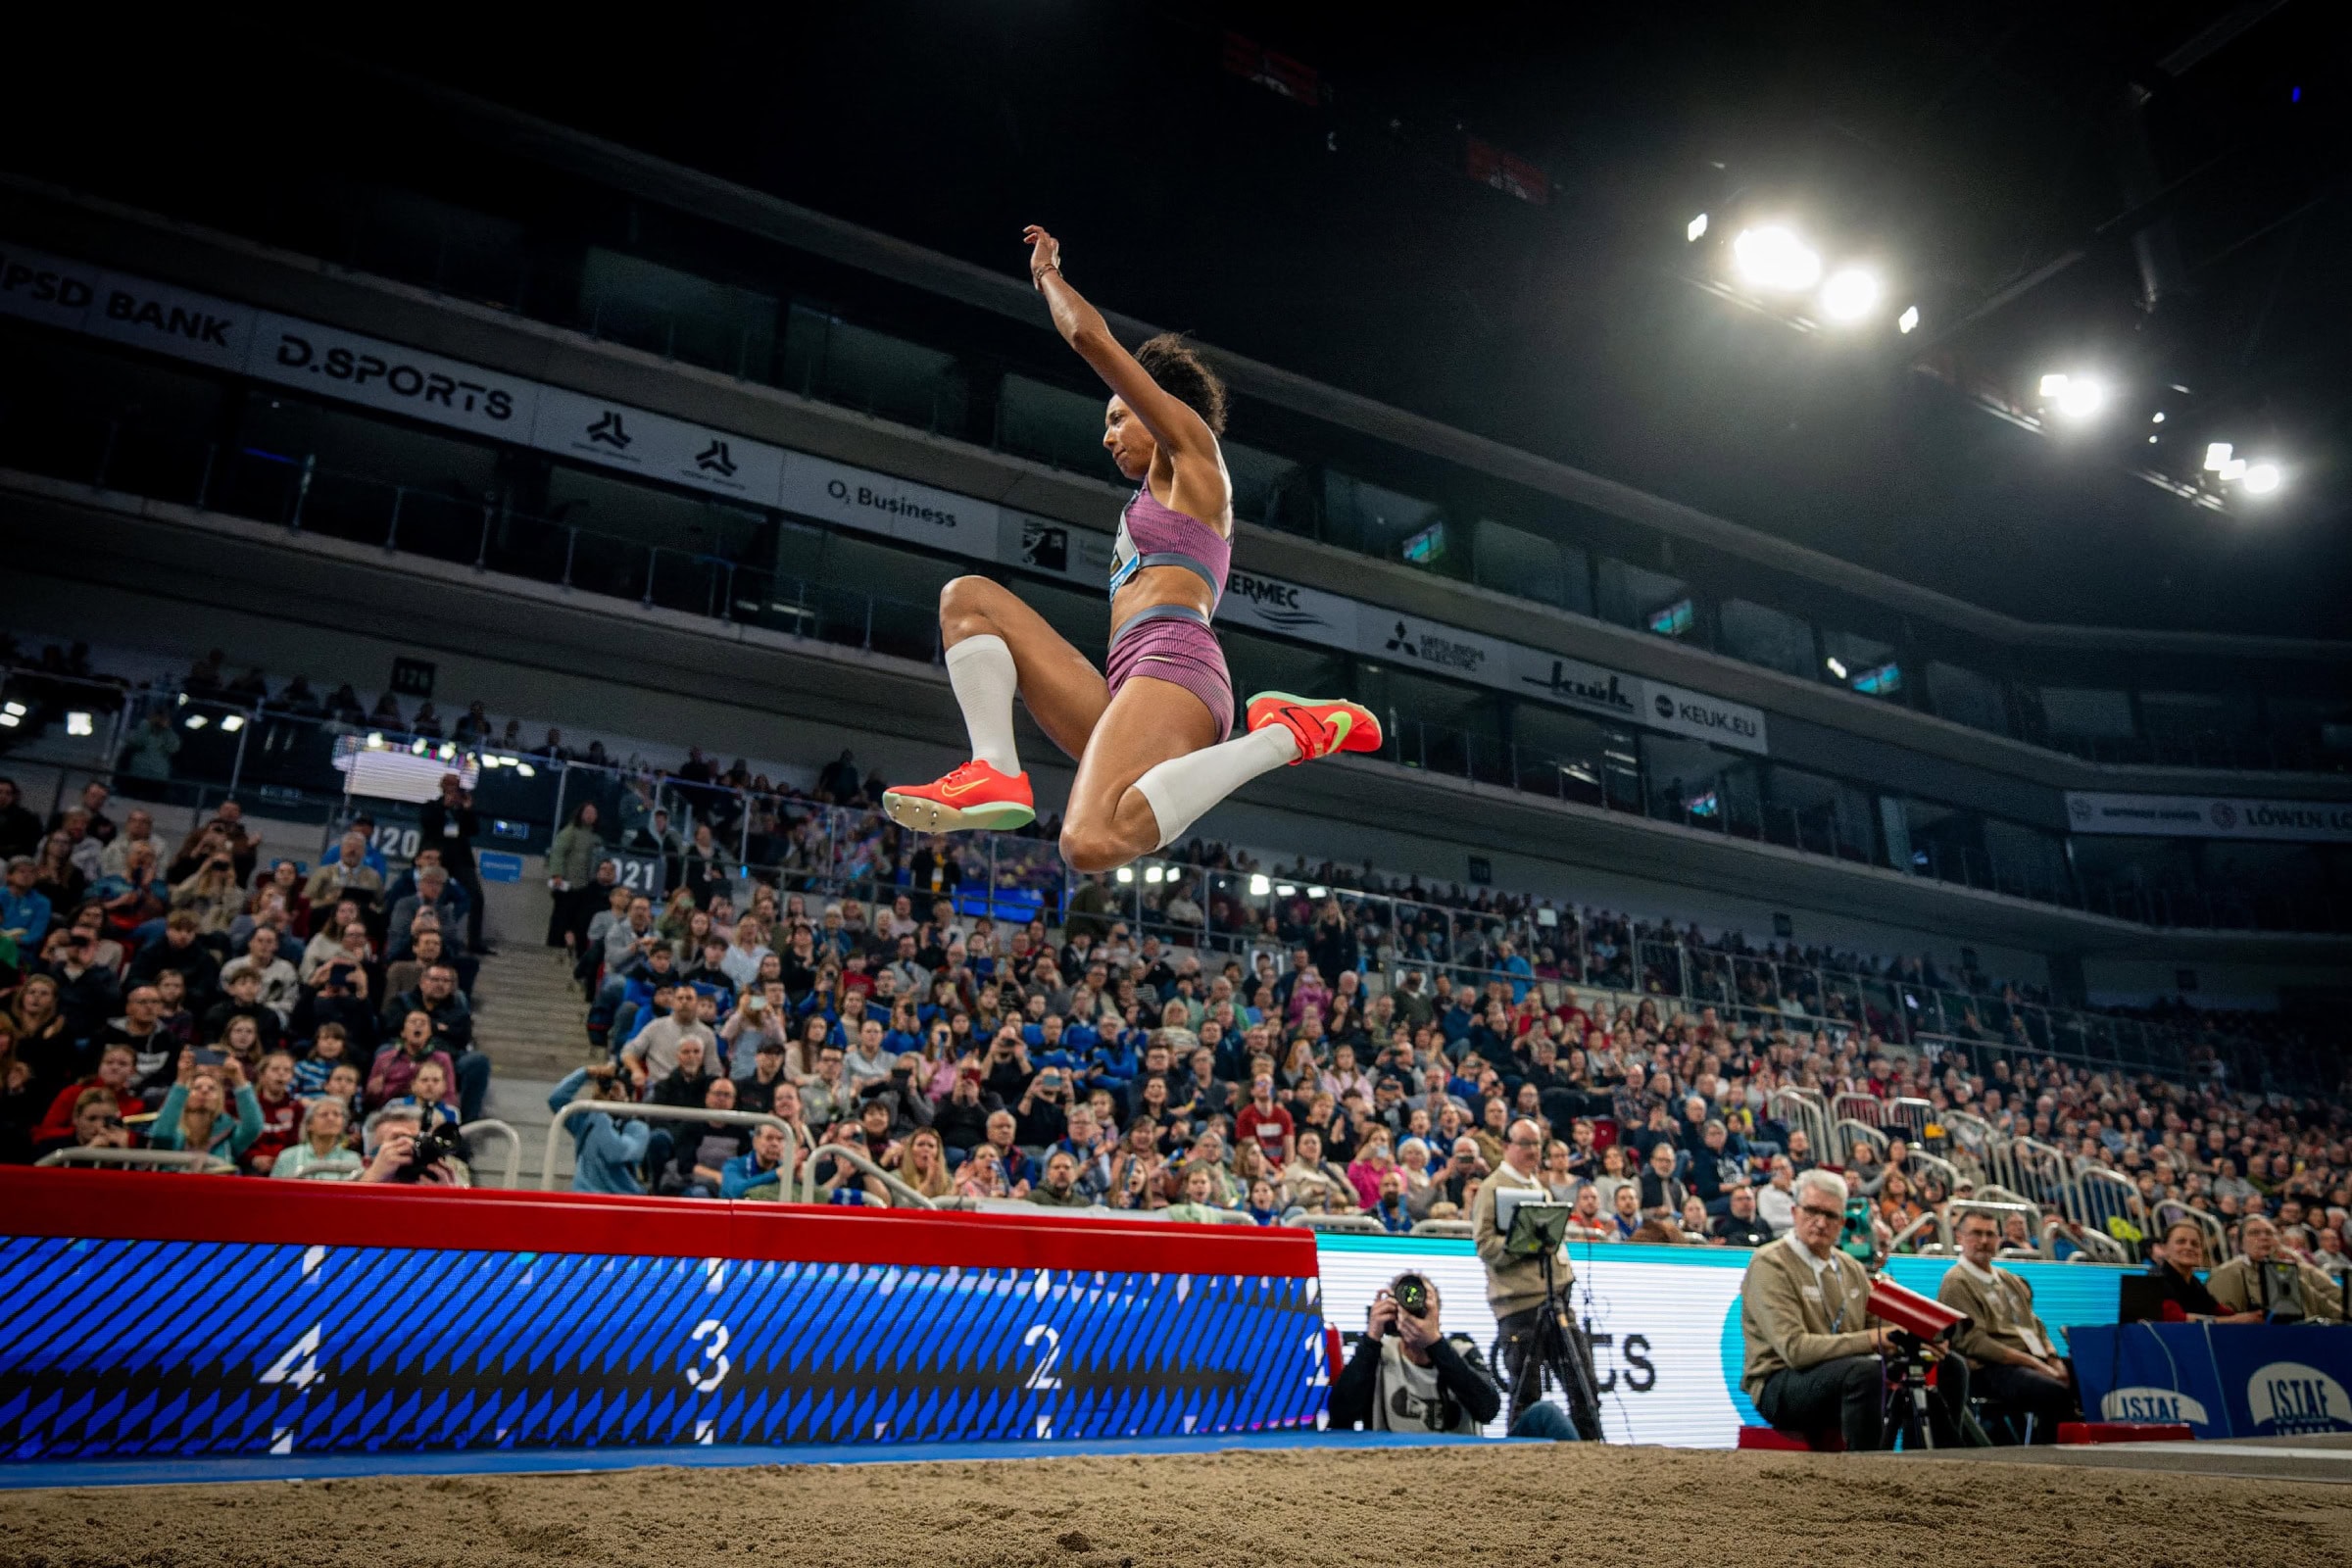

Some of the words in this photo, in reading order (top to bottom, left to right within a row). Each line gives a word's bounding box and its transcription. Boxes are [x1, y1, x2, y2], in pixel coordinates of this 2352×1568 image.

[3, 265, 94, 307] PSD
[106, 290, 232, 347] BANK
[277, 334, 514, 420] D.SPORTS
[857, 487, 957, 527] Business
[1232, 575, 1300, 612] ERMEC
[1679, 702, 1757, 738] KEUK.EU
[260, 1323, 325, 1392] 4
[686, 1318, 731, 1393] 3
[1023, 1323, 1063, 1392] 2
[1304, 1331, 1331, 1387] 1
[2120, 1396, 2180, 1422] ISTAF
[2266, 1378, 2328, 1420] ISTAF
